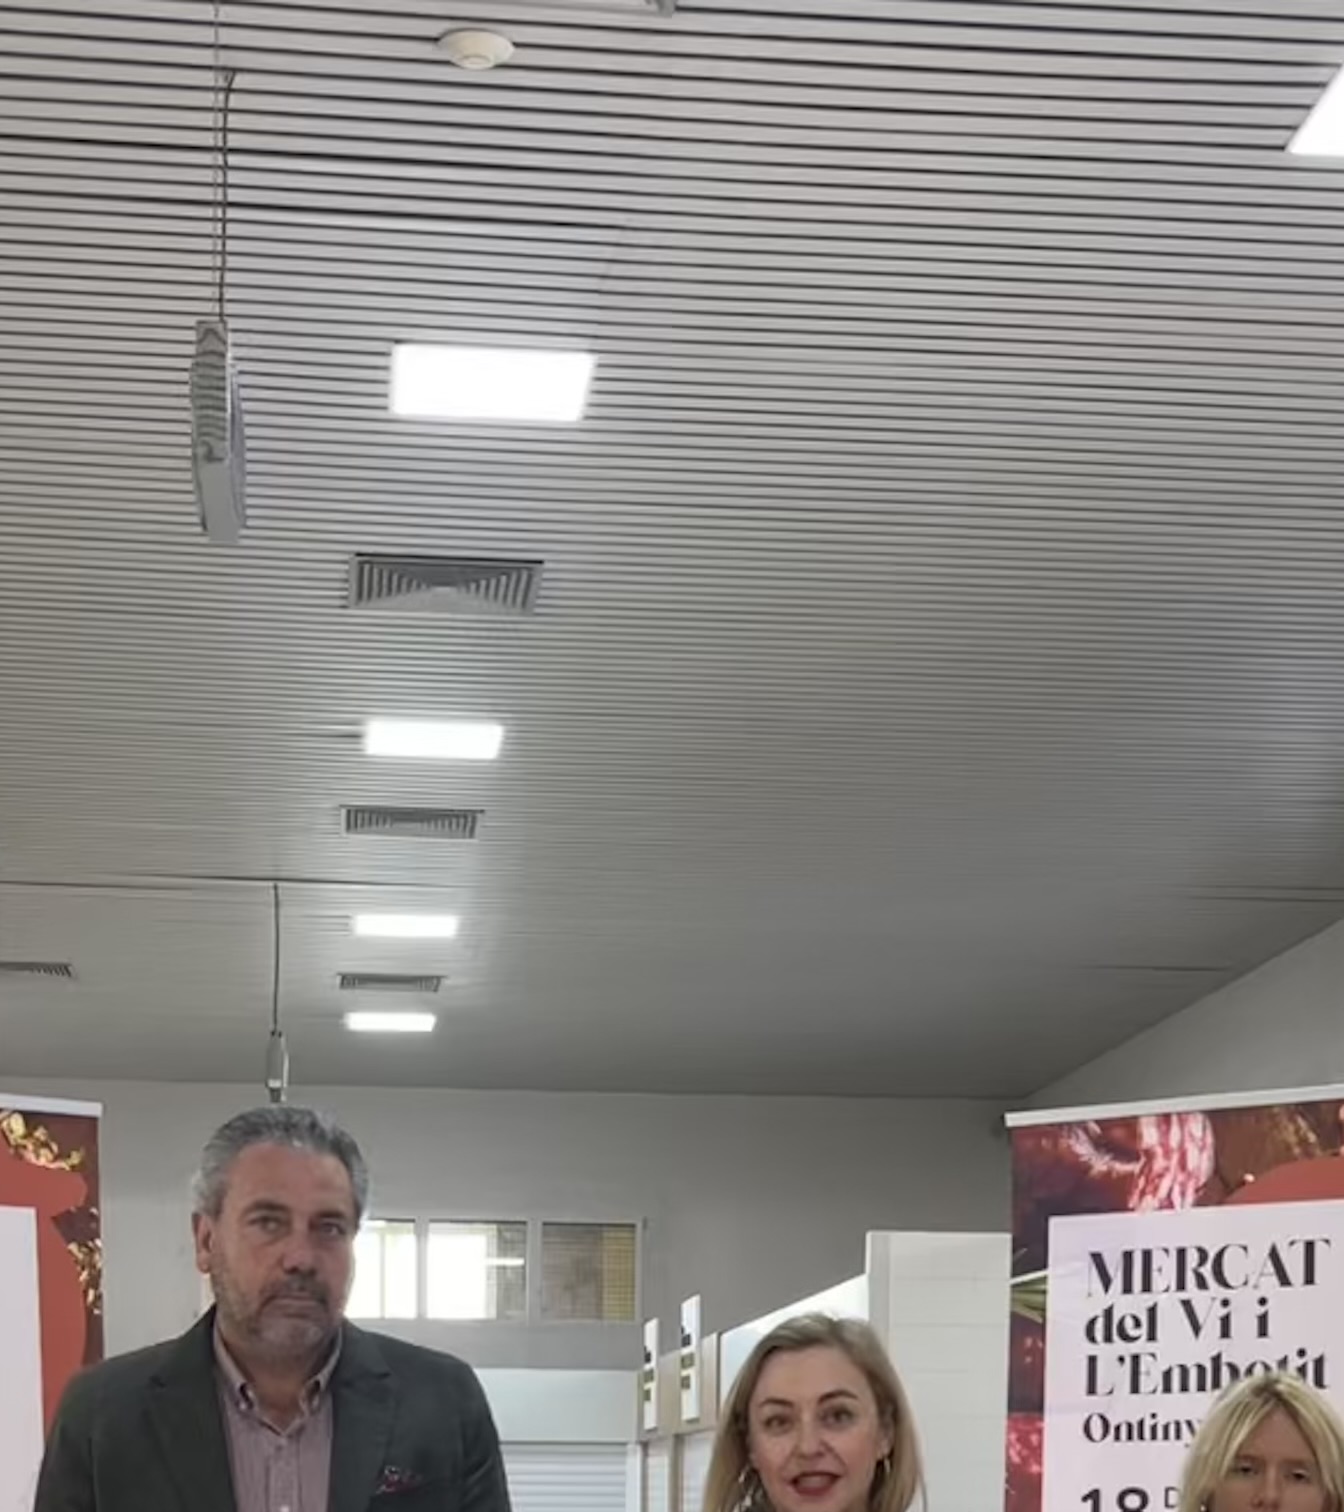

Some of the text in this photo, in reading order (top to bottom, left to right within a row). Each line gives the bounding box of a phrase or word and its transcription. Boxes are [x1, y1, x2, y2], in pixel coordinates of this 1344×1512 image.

[1087, 1238, 1332, 1298] MERCAT
[1085, 1296, 1270, 1345] del Vi i
[1083, 1412, 1204, 1448] Ontiny
